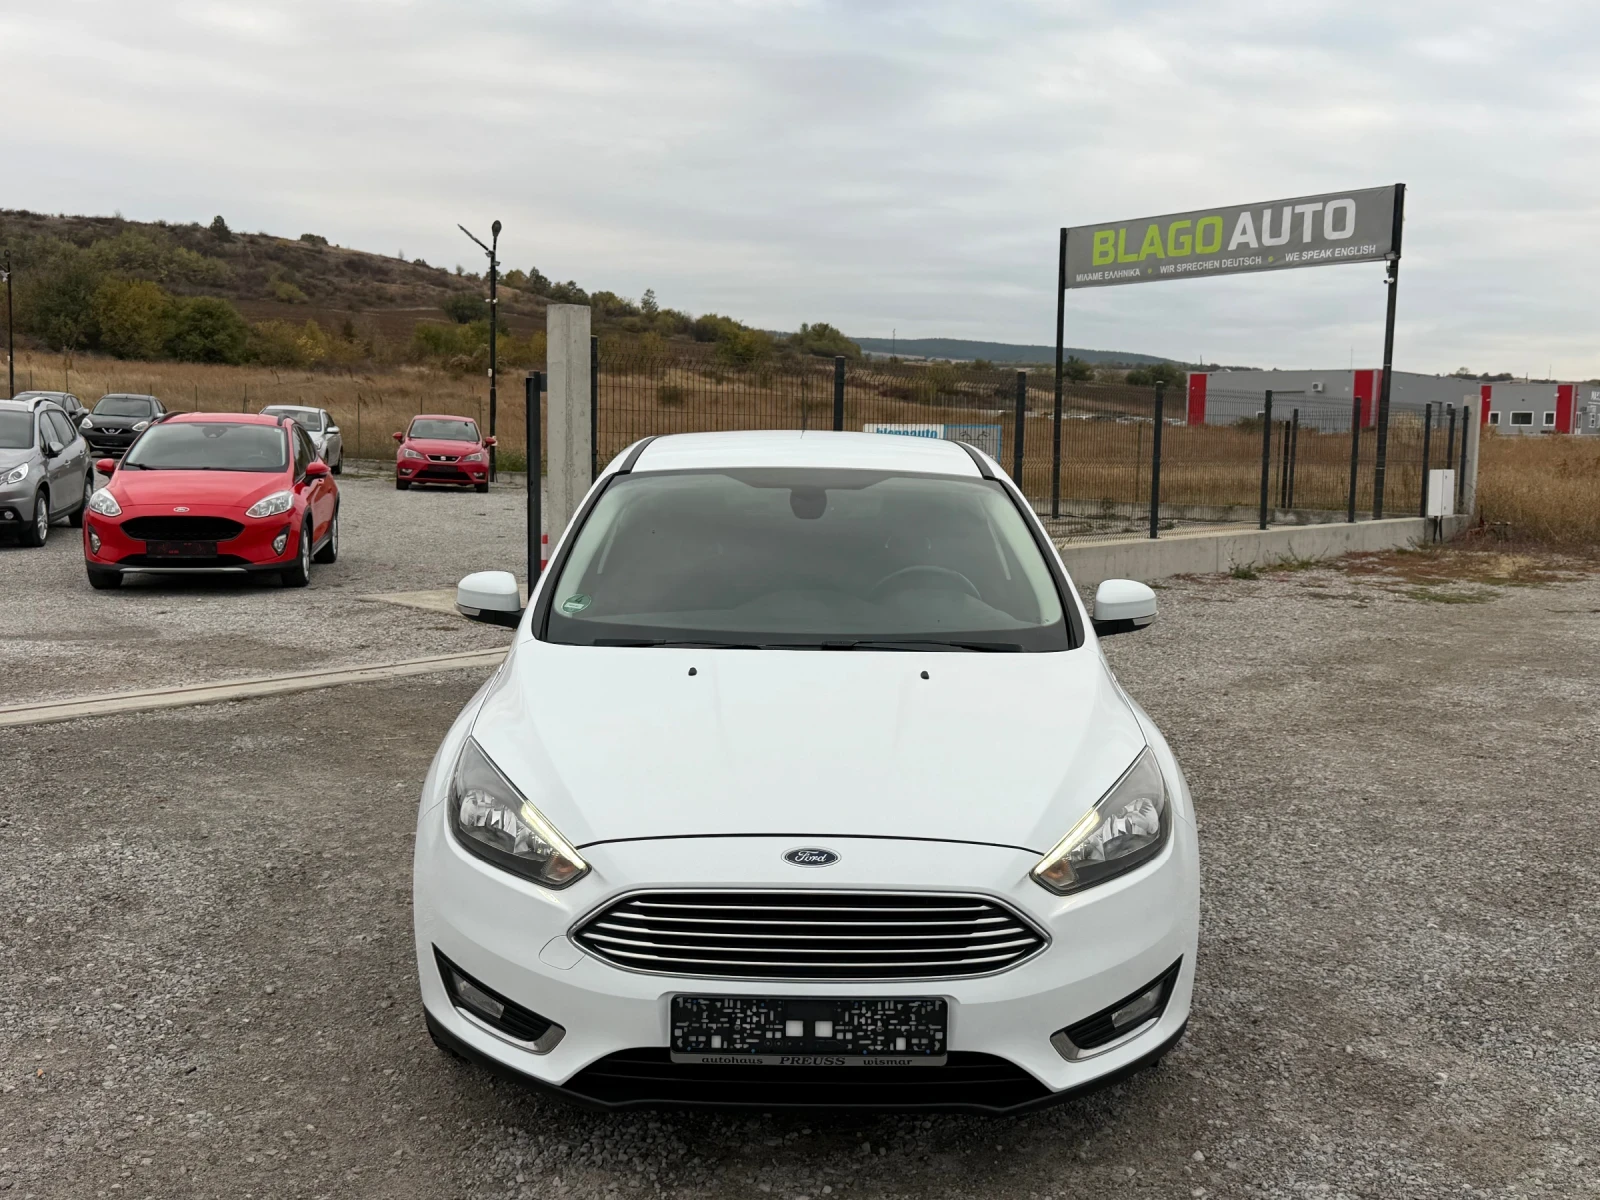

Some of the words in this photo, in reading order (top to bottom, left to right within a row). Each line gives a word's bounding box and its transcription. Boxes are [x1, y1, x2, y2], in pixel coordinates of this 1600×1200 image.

[1092, 215, 1223, 266] BLAGO
[1227, 198, 1356, 251] AUTO
[1285, 251, 1300, 262] WE
[1301, 248, 1333, 260] SPEAK
[1334, 244, 1376, 257] ENGLISH
[1160, 264, 1175, 274] WIR
[1176, 261, 1220, 273] SPRECHEN
[1221, 256, 1262, 268] DEUTSCH
[794, 850, 828, 862] Ford
[701, 1056, 763, 1065] autohaus
[779, 1056, 846, 1066] PREUSS
[862, 1058, 912, 1066] wismar
